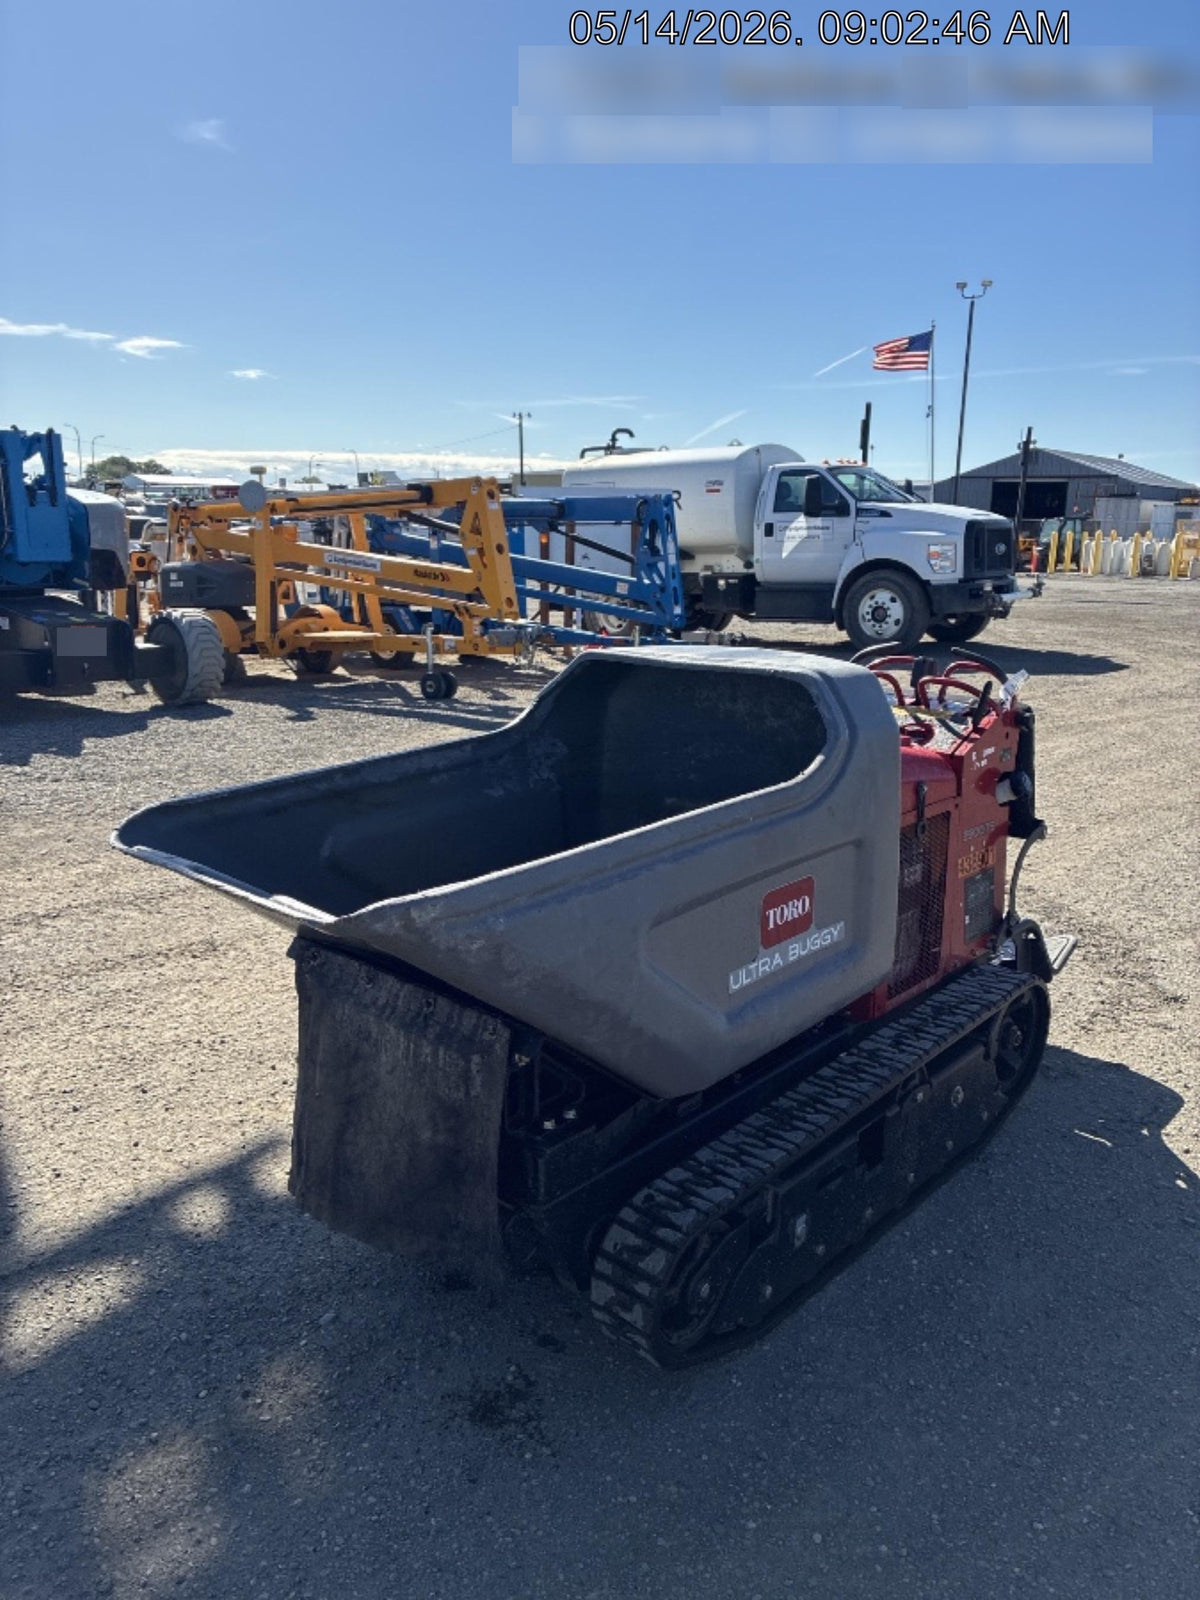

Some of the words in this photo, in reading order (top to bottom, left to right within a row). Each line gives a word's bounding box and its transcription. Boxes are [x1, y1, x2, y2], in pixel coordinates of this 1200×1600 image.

[766, 895, 810, 930] TORO
[729, 952, 783, 990] ULTRA
[788, 921, 844, 961] BUGGY
